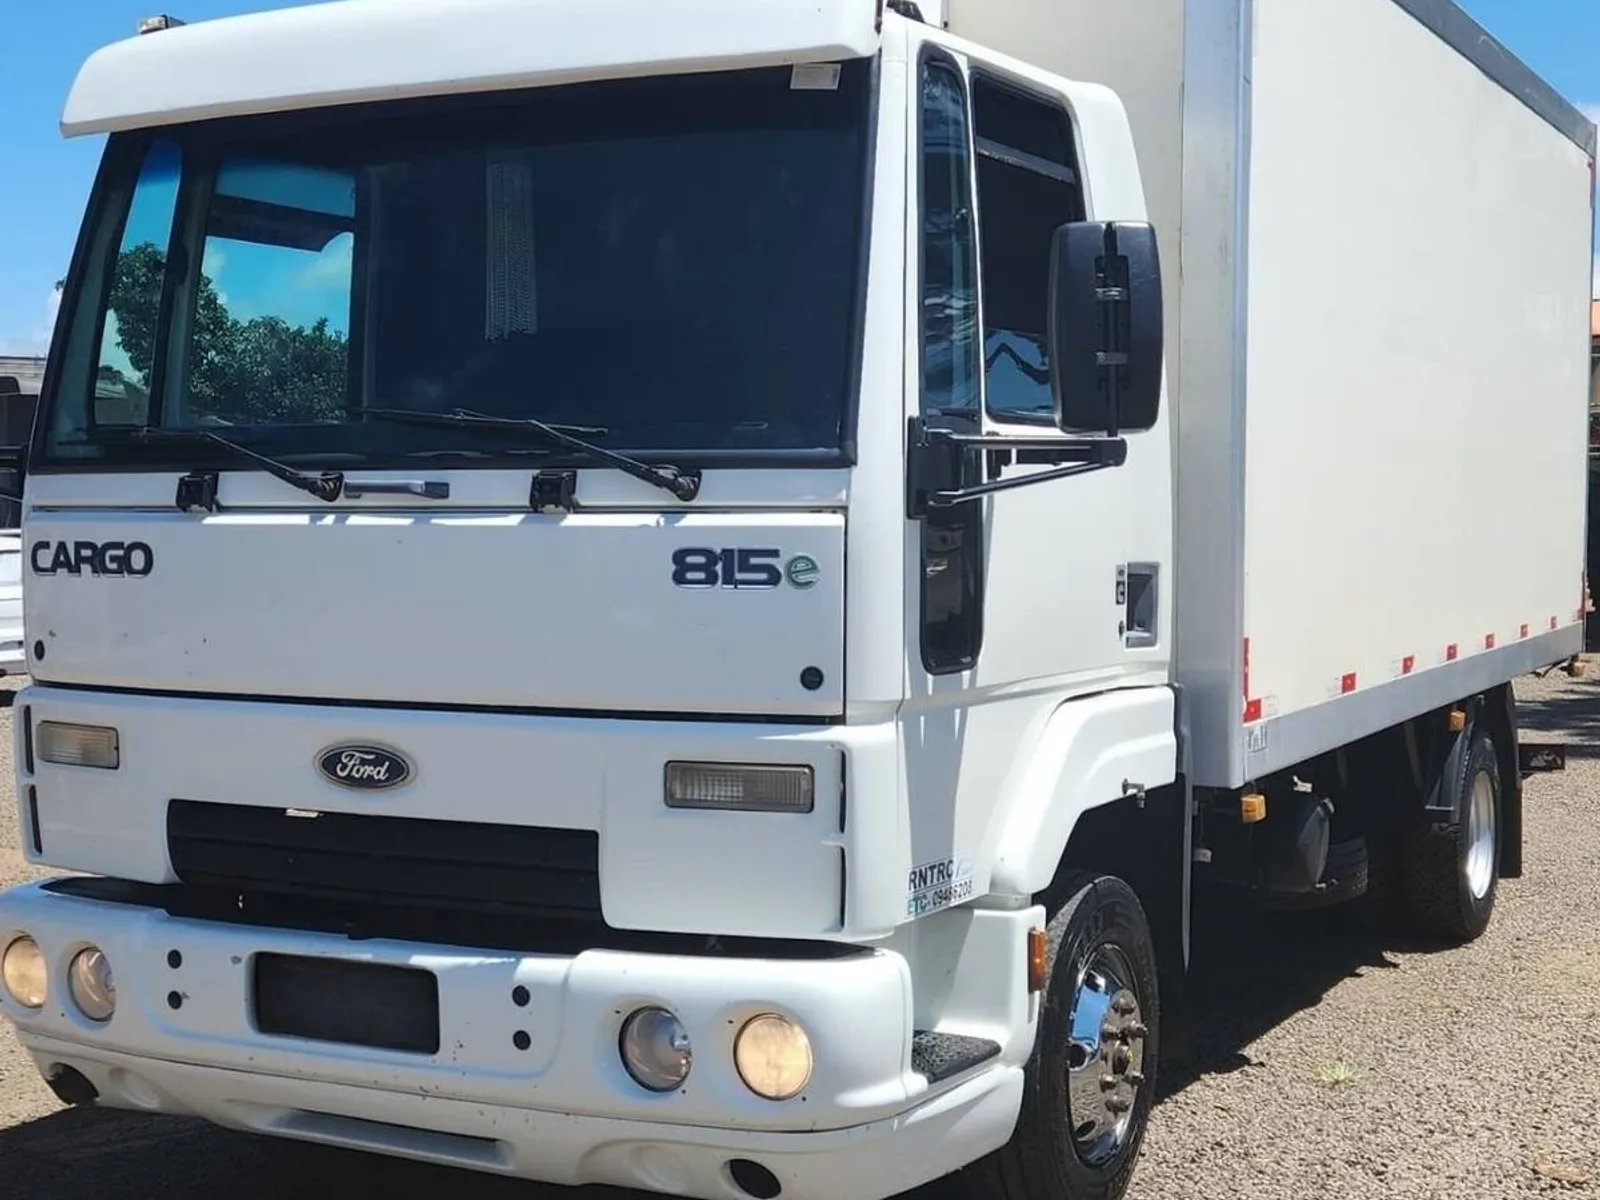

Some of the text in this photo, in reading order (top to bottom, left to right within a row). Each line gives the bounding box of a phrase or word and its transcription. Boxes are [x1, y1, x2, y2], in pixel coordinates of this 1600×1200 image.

[31, 540, 154, 577] CARGO
[336, 751, 390, 780] Ford
[908, 859, 954, 891] RNTRC
